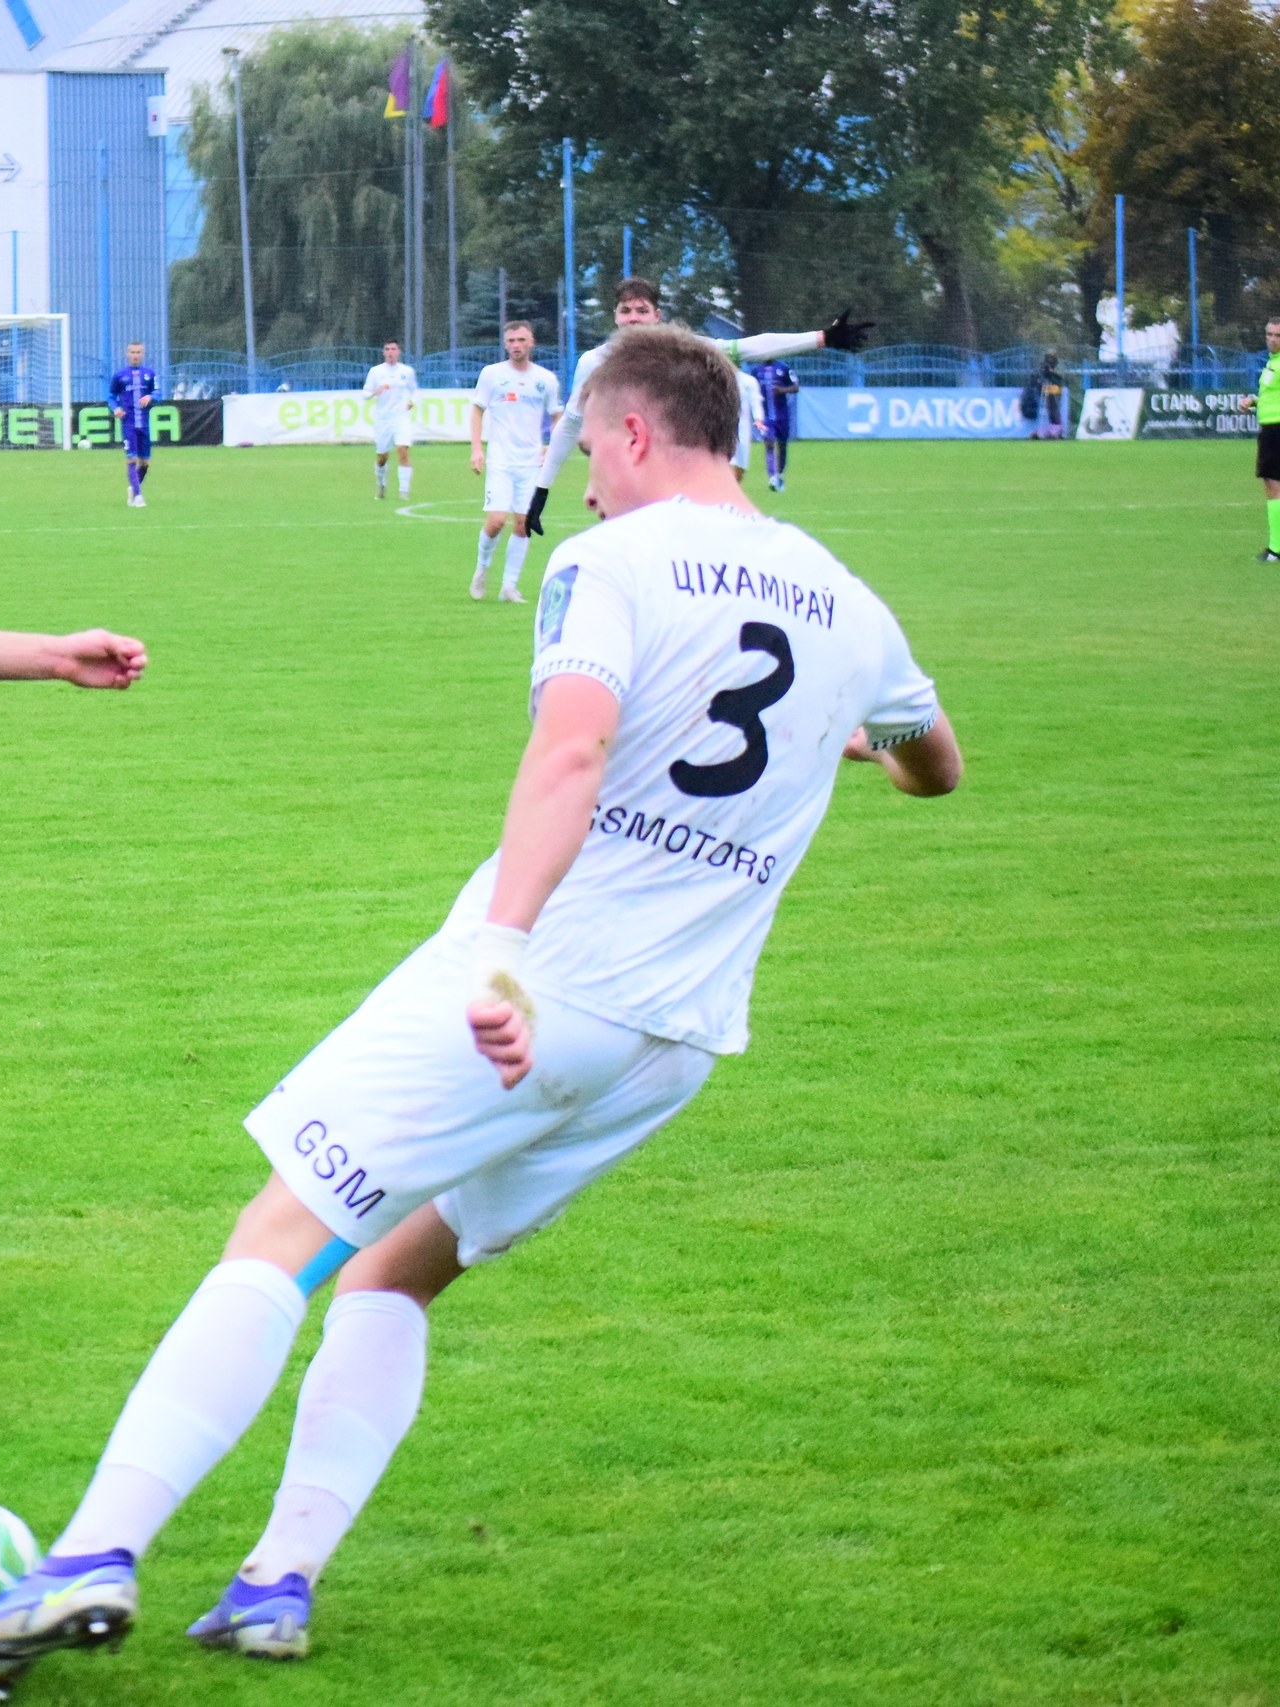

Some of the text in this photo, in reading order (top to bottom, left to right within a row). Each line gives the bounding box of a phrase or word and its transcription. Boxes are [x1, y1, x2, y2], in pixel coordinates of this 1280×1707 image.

[277, 397, 470, 437] еврпт
[889, 398, 1021, 429] DATKOM
[1150, 393, 1203, 413] СТАНЬ
[671, 559, 835, 629] ЦІХАМІРАЎ
[669, 621, 795, 798] 3
[294, 1120, 387, 1220] GSM
